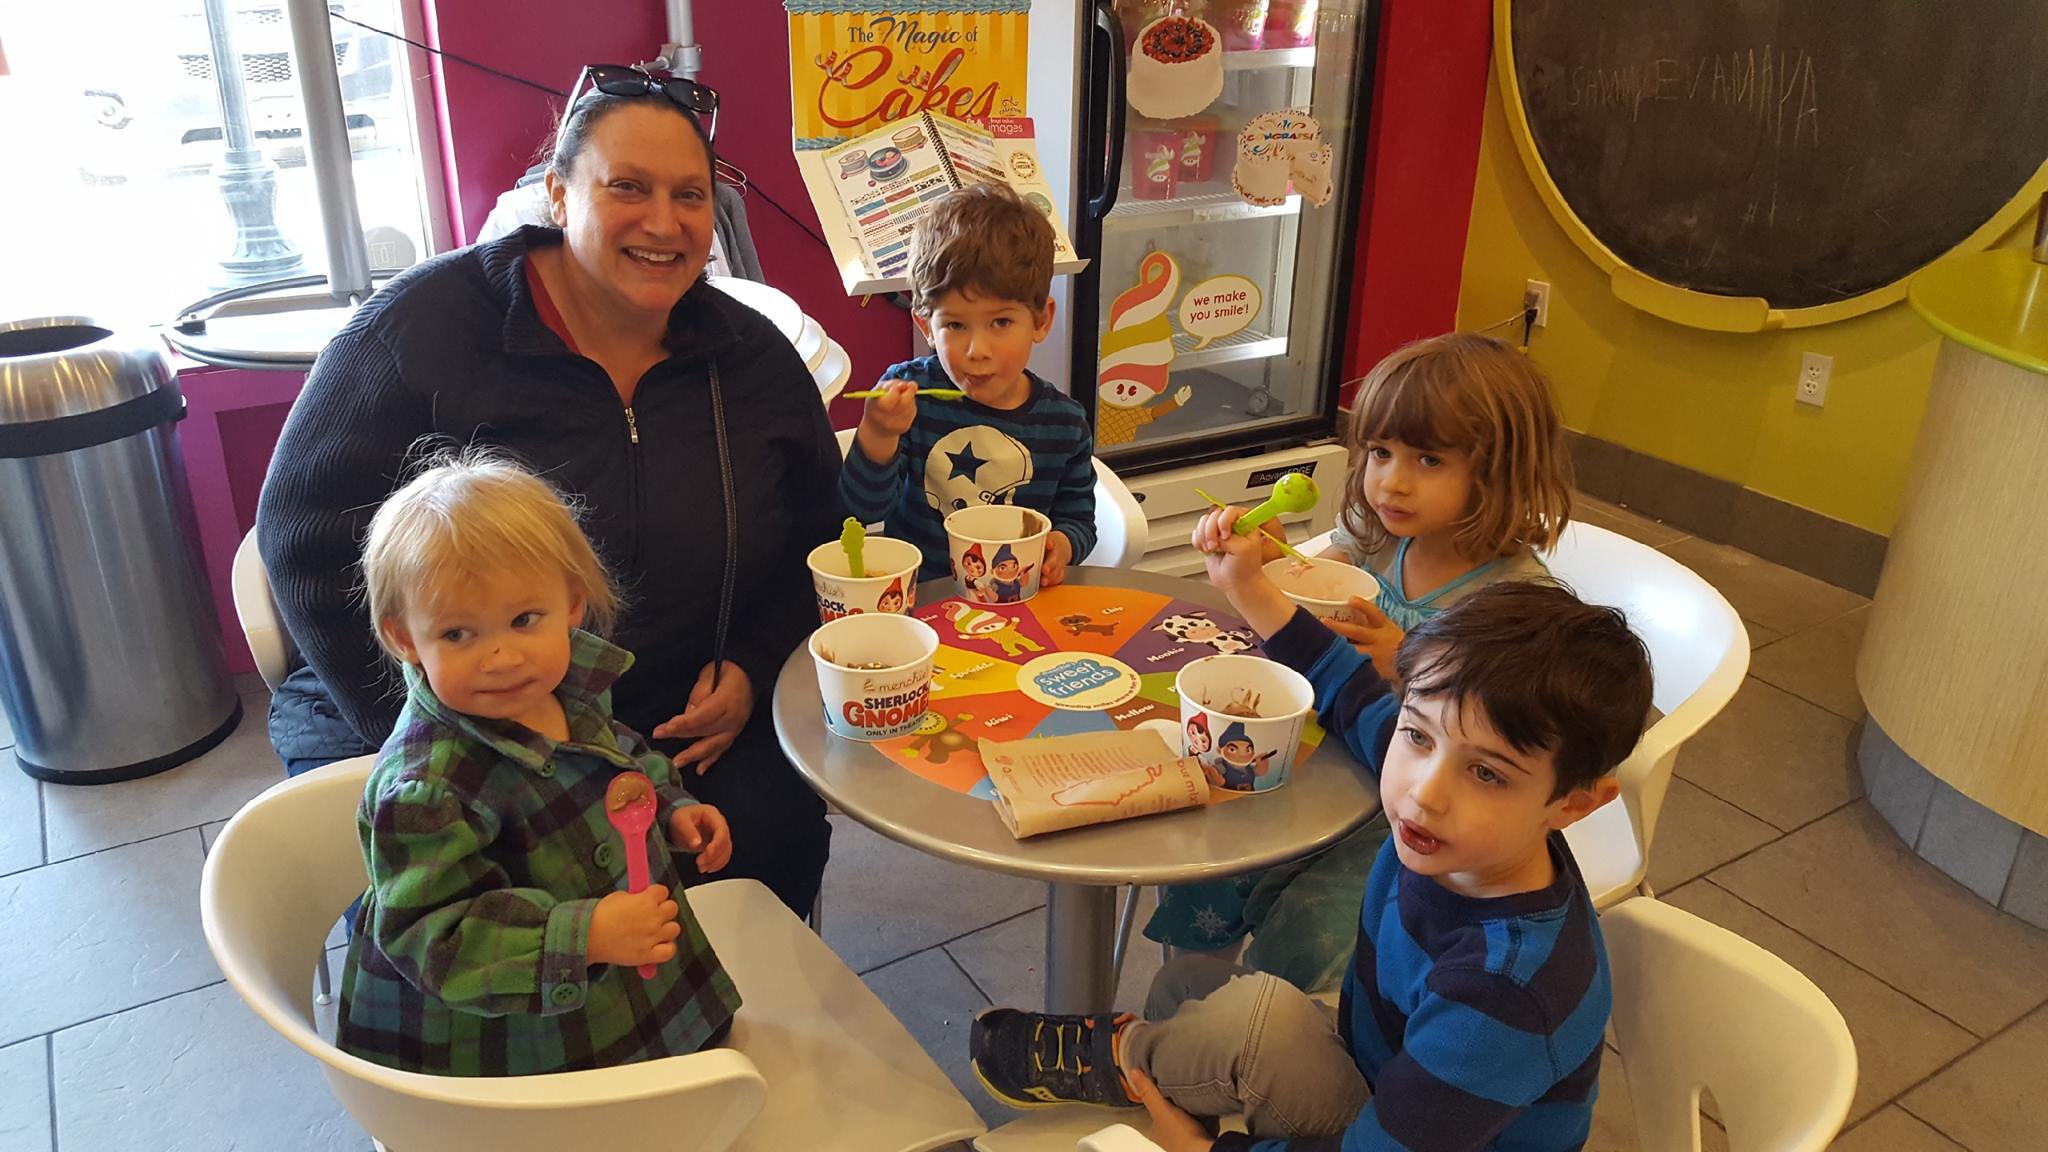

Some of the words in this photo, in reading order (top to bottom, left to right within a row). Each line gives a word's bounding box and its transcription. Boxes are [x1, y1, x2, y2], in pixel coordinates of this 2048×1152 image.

[848, 26, 874, 43] The
[869, 16, 963, 54] Magic
[965, 27, 979, 43] of
[818, 45, 1001, 128] Cakes
[988, 123, 1024, 135] images
[1193, 296, 1210, 307] we
[1214, 290, 1247, 304] make
[1190, 310, 1210, 324] you
[1039, 661, 1096, 687] sweet
[1047, 668, 1115, 696] friends
[864, 681, 931, 710] SHERLOCK
[842, 693, 929, 729] GNOME
[984, 713, 1015, 728] Kiwi
[1114, 703, 1155, 721] Mallow
[866, 728, 888, 737] ONLY
[889, 727, 898, 735] IN
